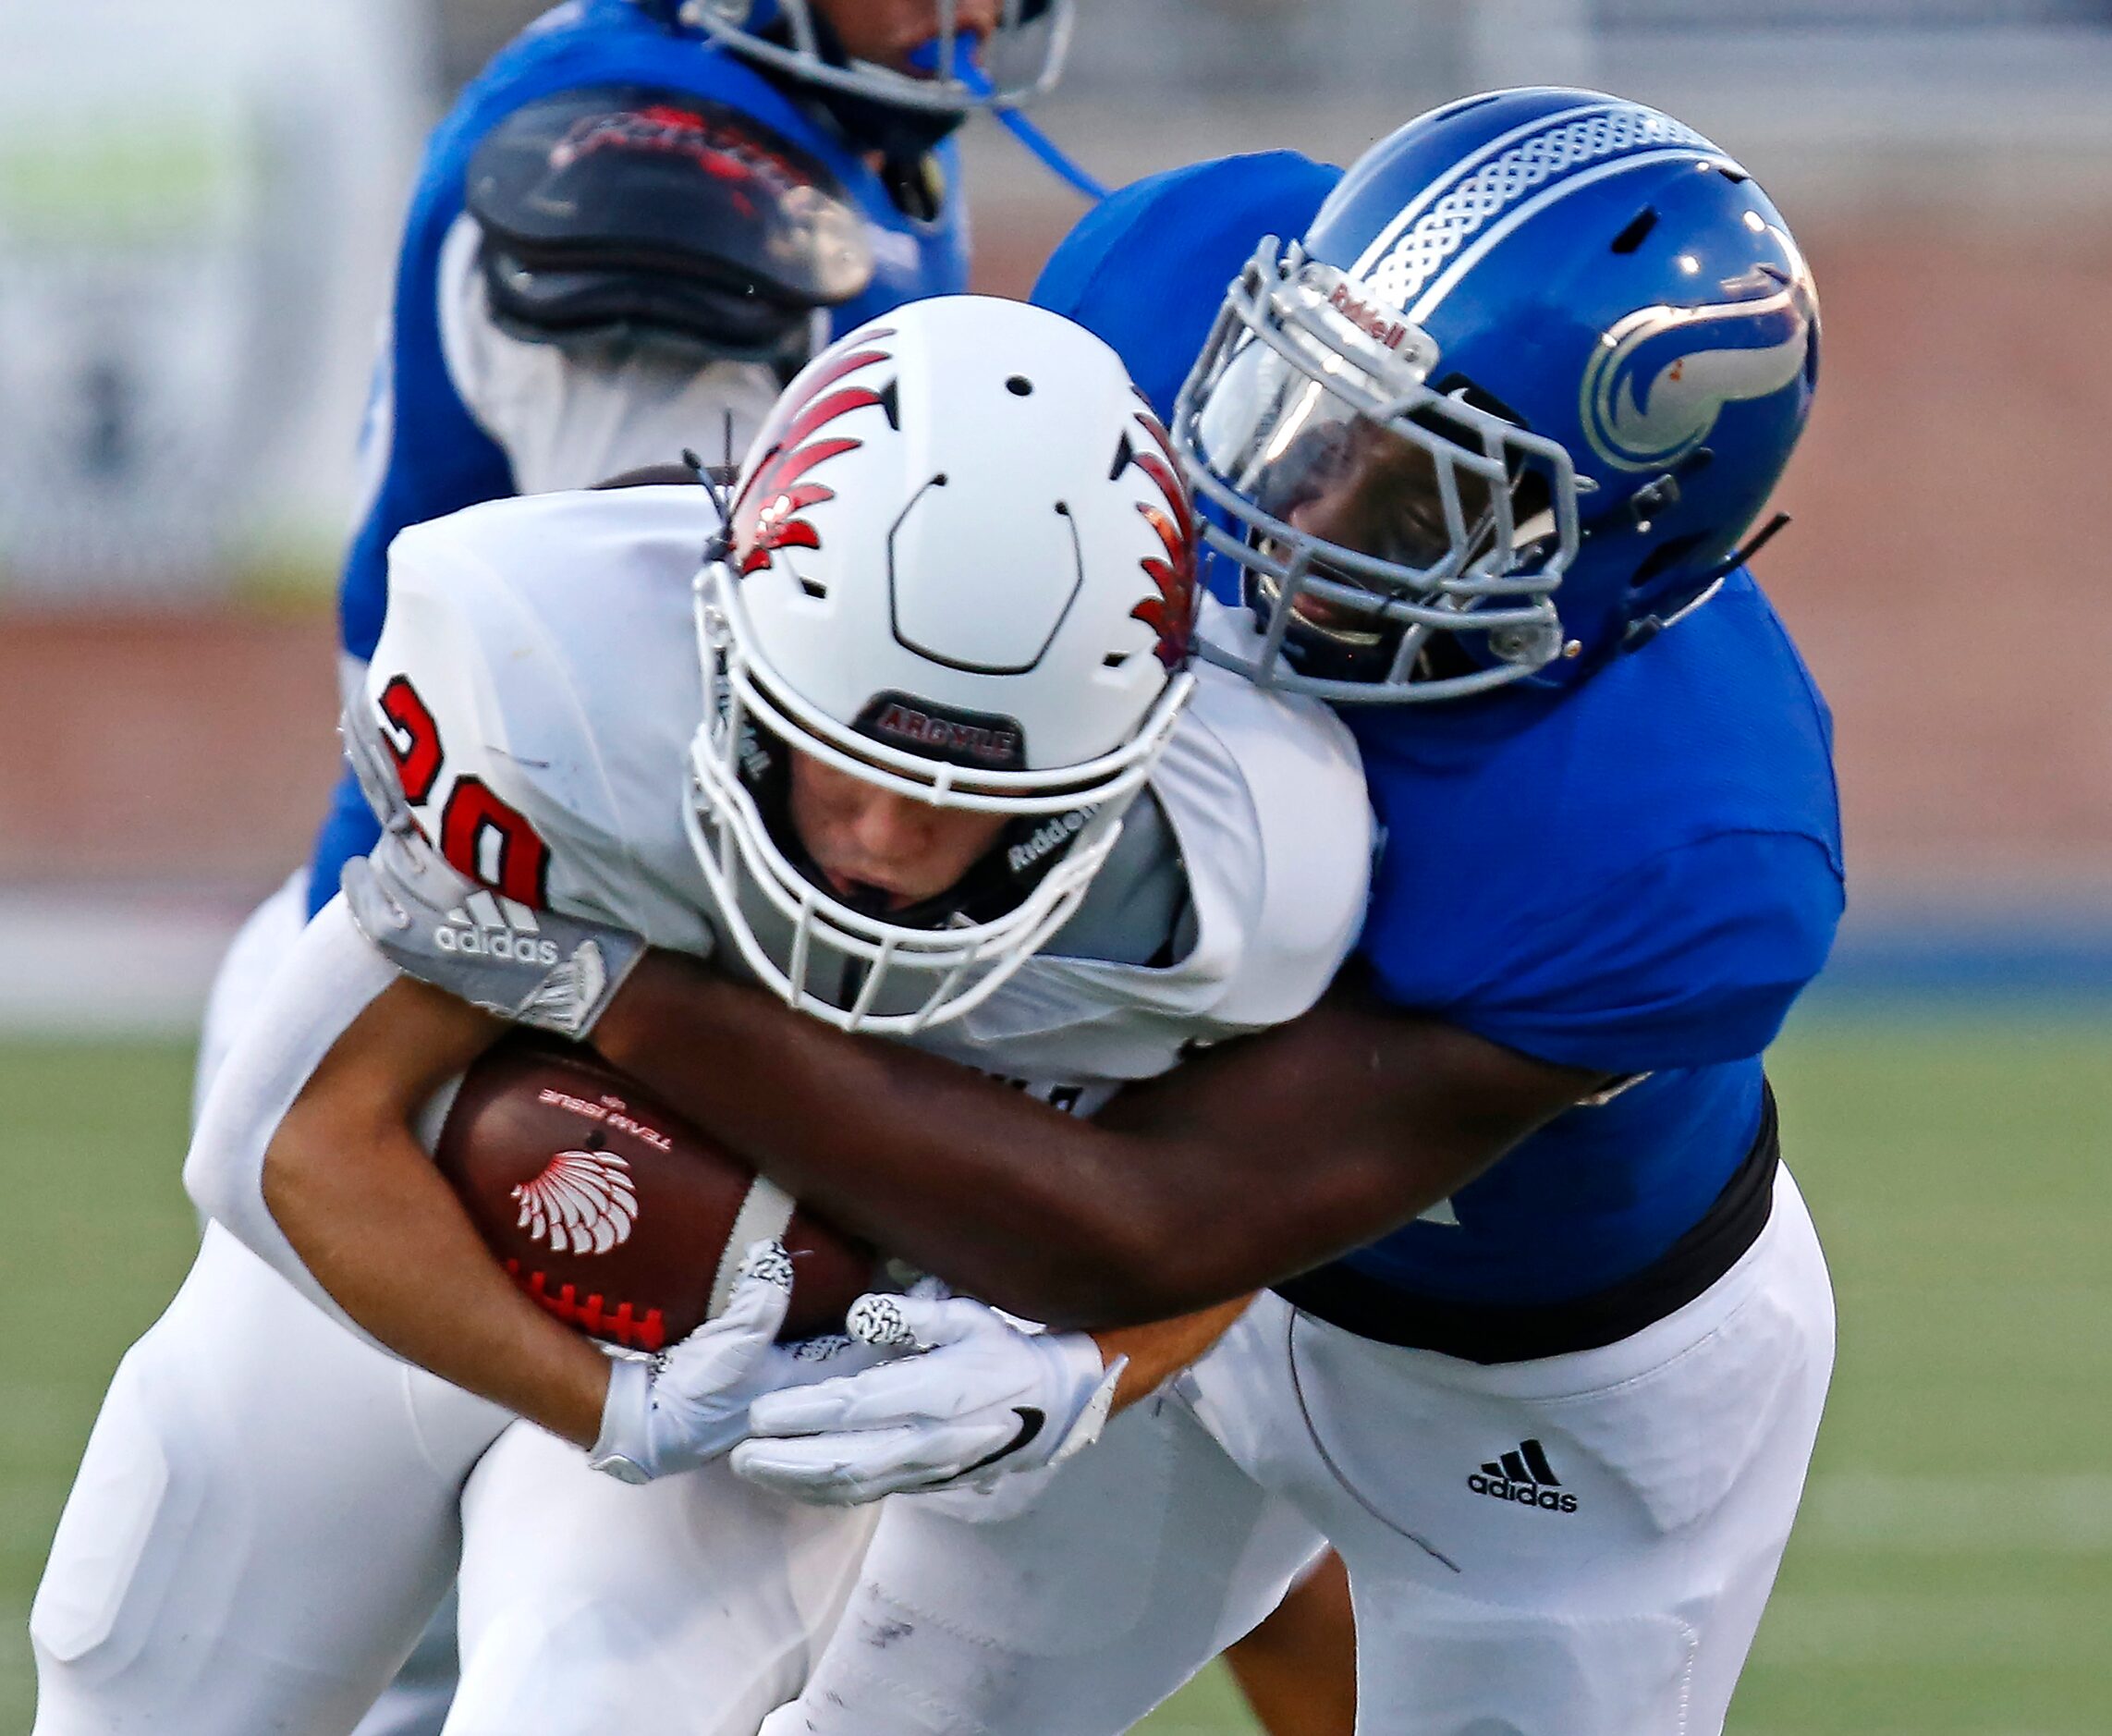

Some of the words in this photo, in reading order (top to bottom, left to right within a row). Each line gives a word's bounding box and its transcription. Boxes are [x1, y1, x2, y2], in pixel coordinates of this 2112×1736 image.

[876, 702, 1018, 758] ARGYLE
[433, 923, 559, 965] adidas
[537, 1087, 608, 1121] ISSUE
[606, 1112, 672, 1152] TEAM
[1468, 1473, 1578, 1513] adidas
